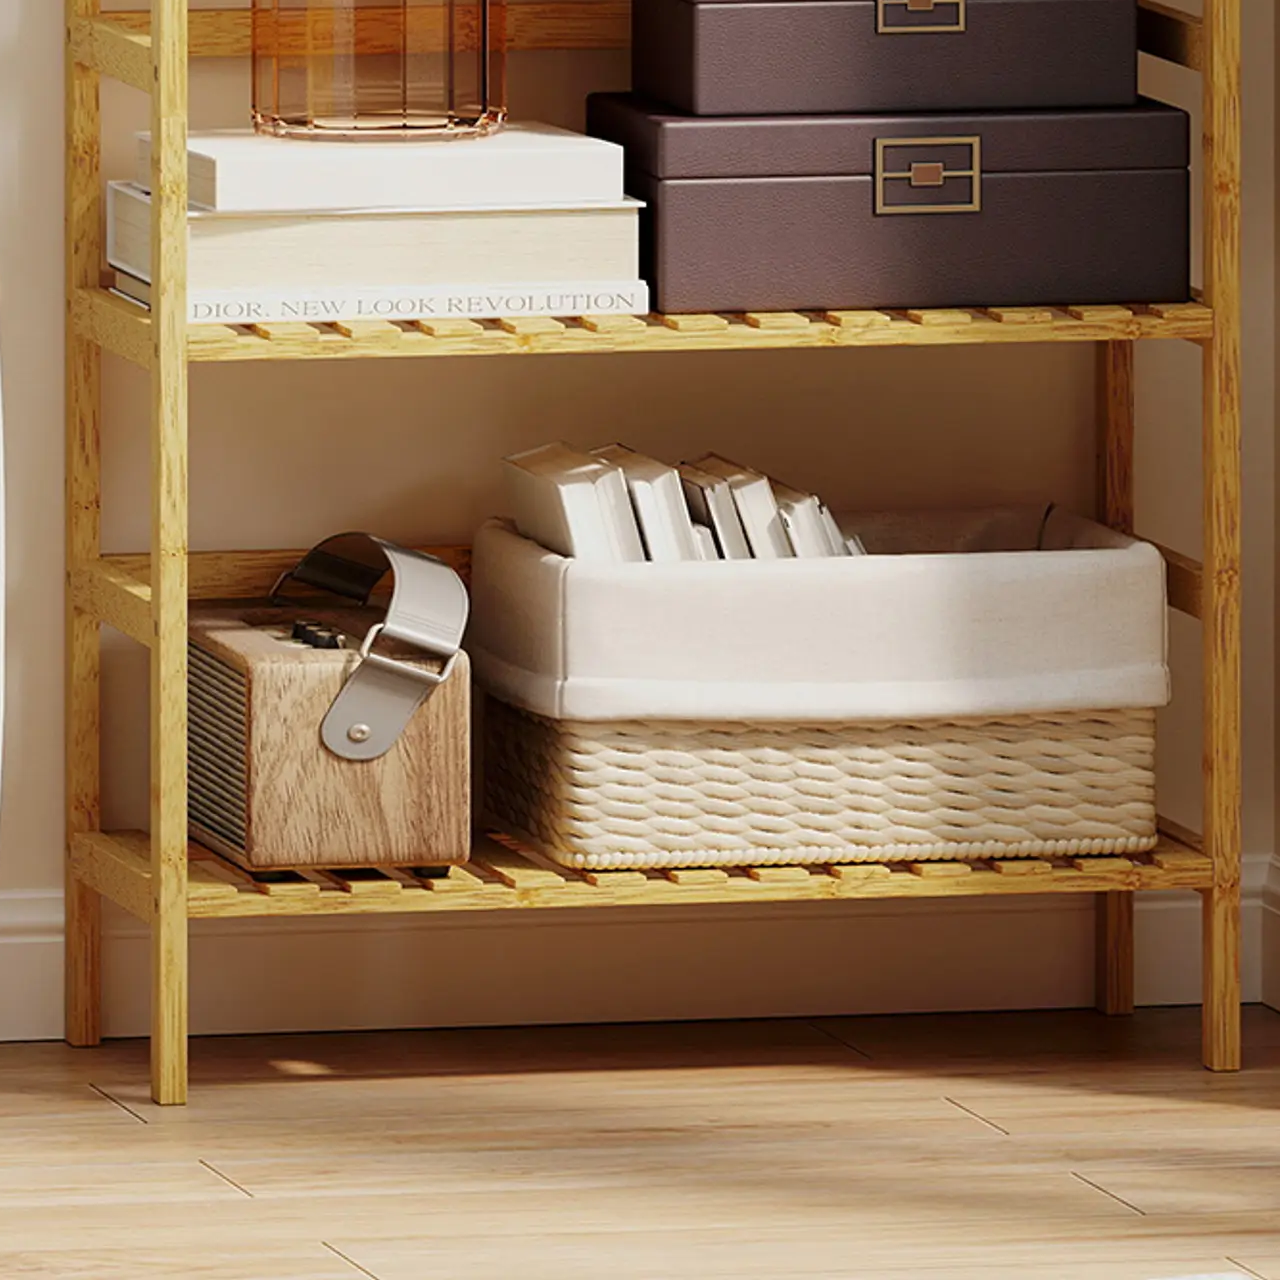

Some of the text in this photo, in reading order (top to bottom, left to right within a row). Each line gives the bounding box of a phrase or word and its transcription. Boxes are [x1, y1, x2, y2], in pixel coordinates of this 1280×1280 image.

[192, 291, 636, 320] DIOR. NEW LOOK REVOLUTION
